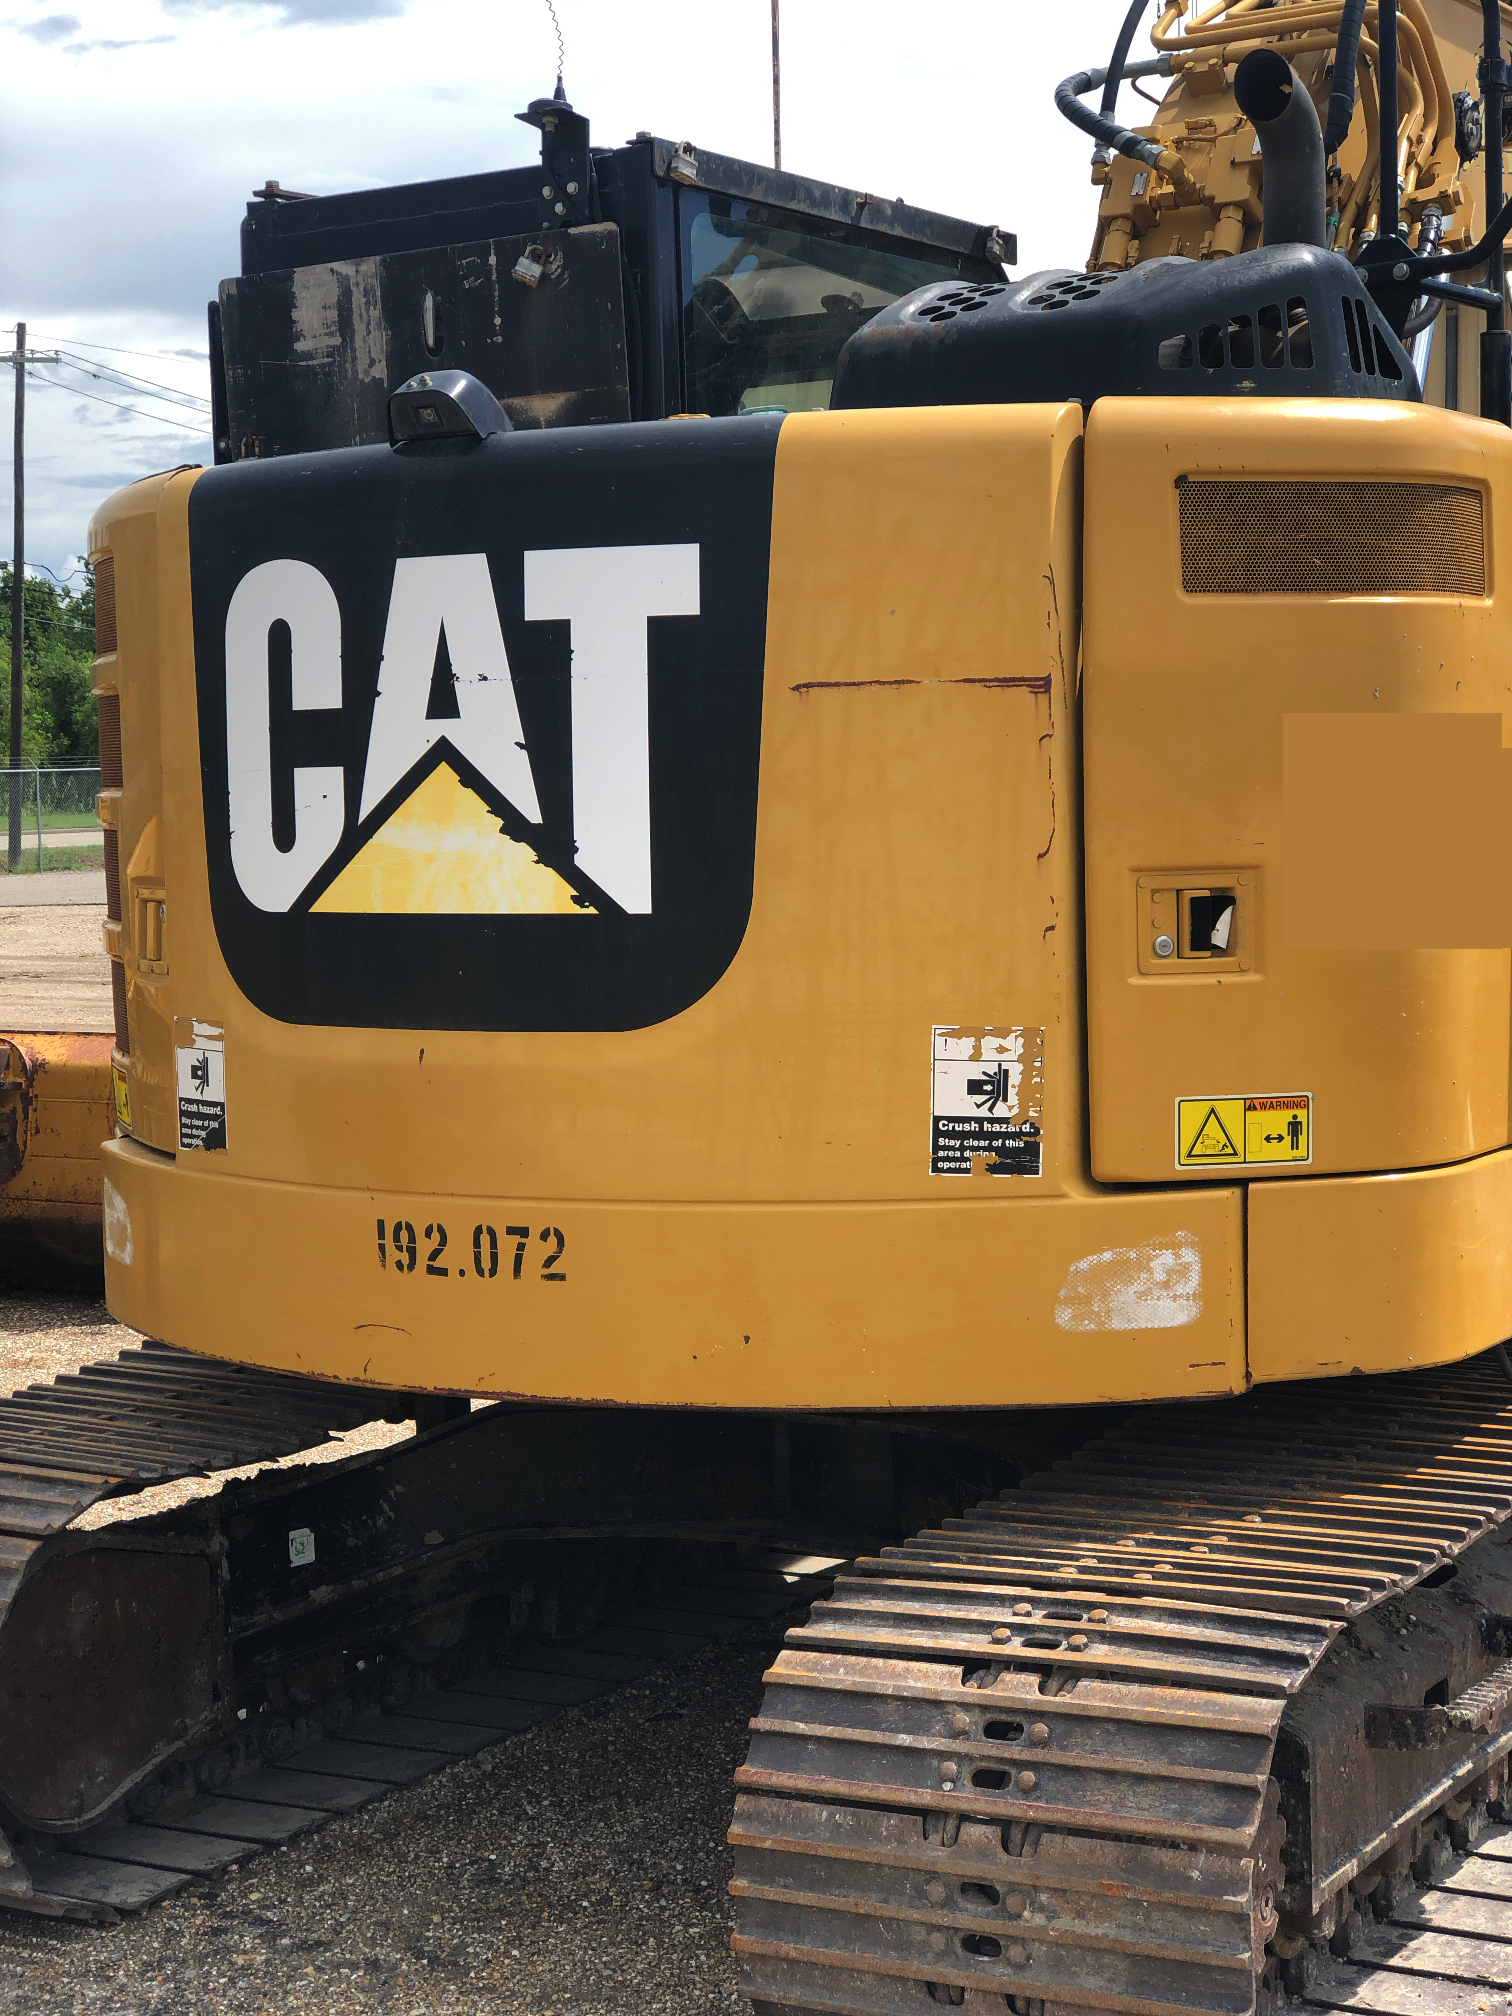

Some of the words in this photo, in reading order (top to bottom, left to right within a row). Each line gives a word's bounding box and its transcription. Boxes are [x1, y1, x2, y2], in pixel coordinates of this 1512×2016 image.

[225, 543, 701, 914] CAT
[181, 1101, 198, 1112] Crush
[199, 1104, 222, 1115] hazard.
[1258, 1099, 1307, 1110] WARNING
[181, 1117, 191, 1126] Stay
[192, 1118, 203, 1126] clear
[938, 1120, 979, 1132] Crush
[983, 1121, 1035, 1133] hazard.
[937, 1137, 961, 1148] Stay
[963, 1138, 990, 1147] clear
[992, 1138, 1003, 1148] of
[1005, 1139, 1025, 1148] this
[376, 1218, 567, 1282] 192.072
